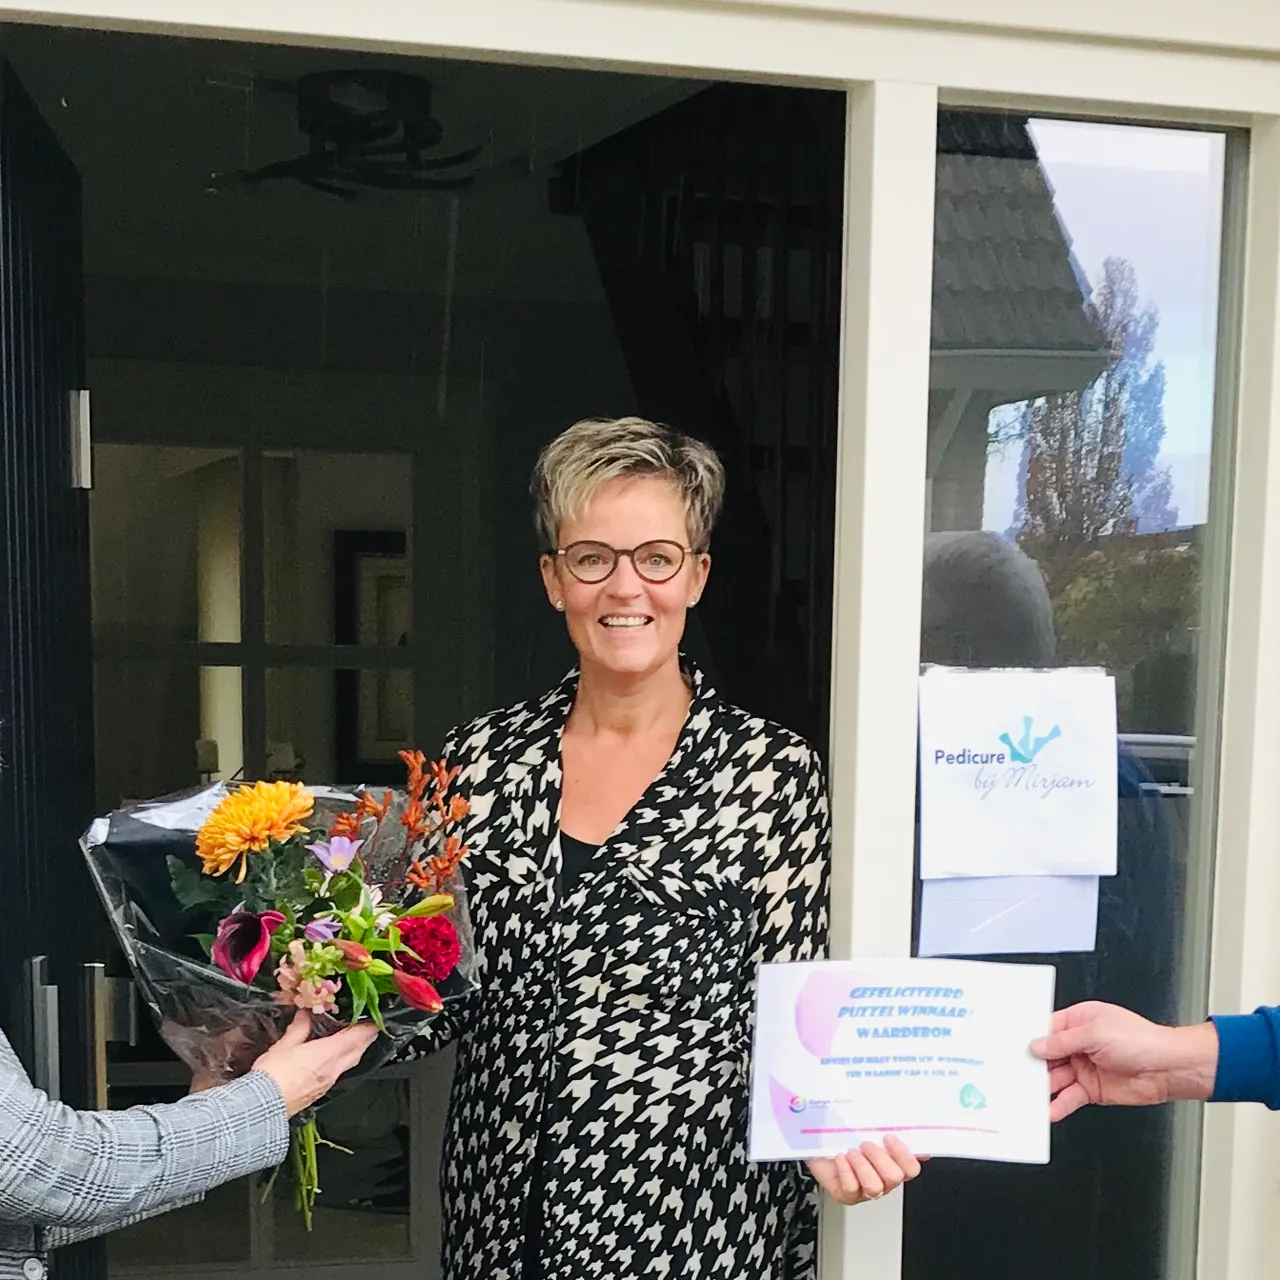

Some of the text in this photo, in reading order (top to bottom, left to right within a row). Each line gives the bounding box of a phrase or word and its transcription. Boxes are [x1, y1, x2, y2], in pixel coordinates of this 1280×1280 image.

[934, 748, 1006, 765] Pedicure
[974, 763, 1096, 800] bij Mirjam
[856, 1026, 952, 1038] WAARDEBON
